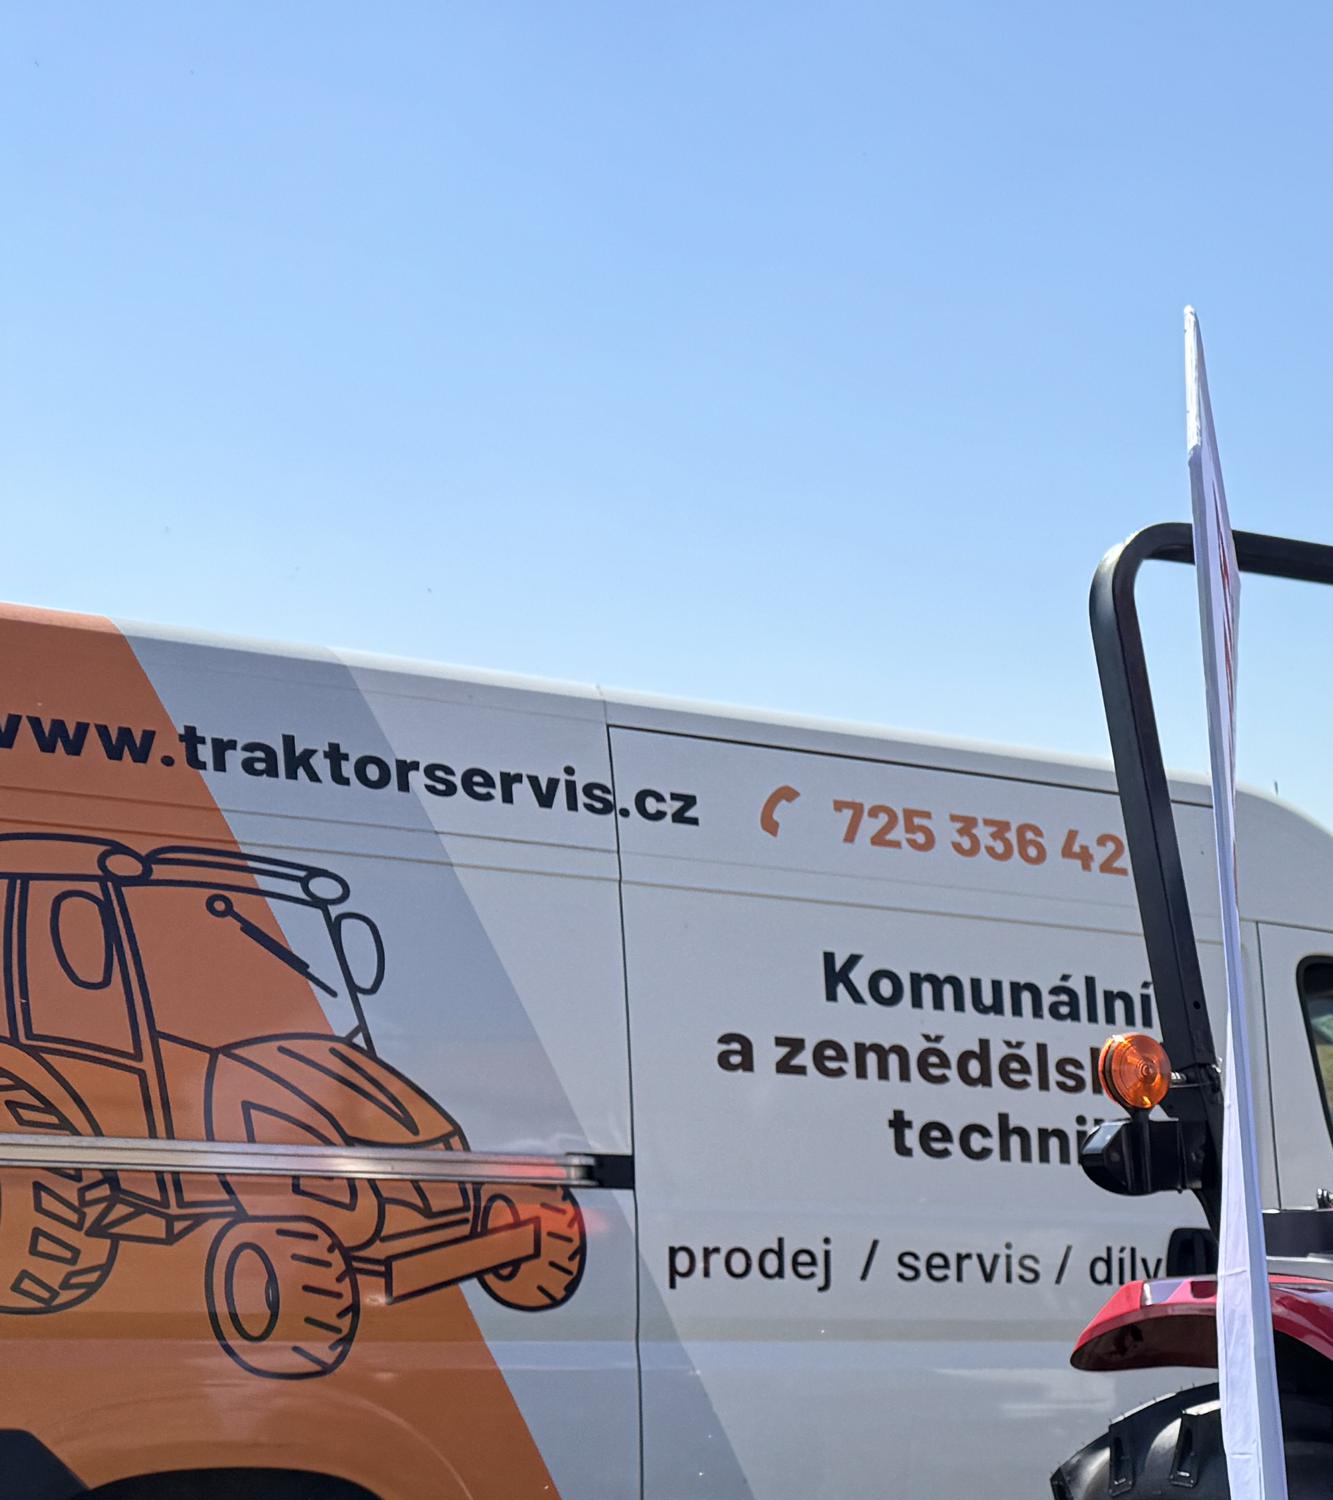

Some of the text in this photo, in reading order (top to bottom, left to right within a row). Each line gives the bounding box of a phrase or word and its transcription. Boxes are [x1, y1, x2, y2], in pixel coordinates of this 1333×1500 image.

[833, 799, 1129, 876] 725 336 42
[822, 950, 1153, 1029] Komunální
[717, 1032, 1104, 1095] a zeměděls
[888, 1109, 1105, 1166] techni
[668, 1237, 832, 1292] prodej
[897, 1241, 1041, 1285] servis
